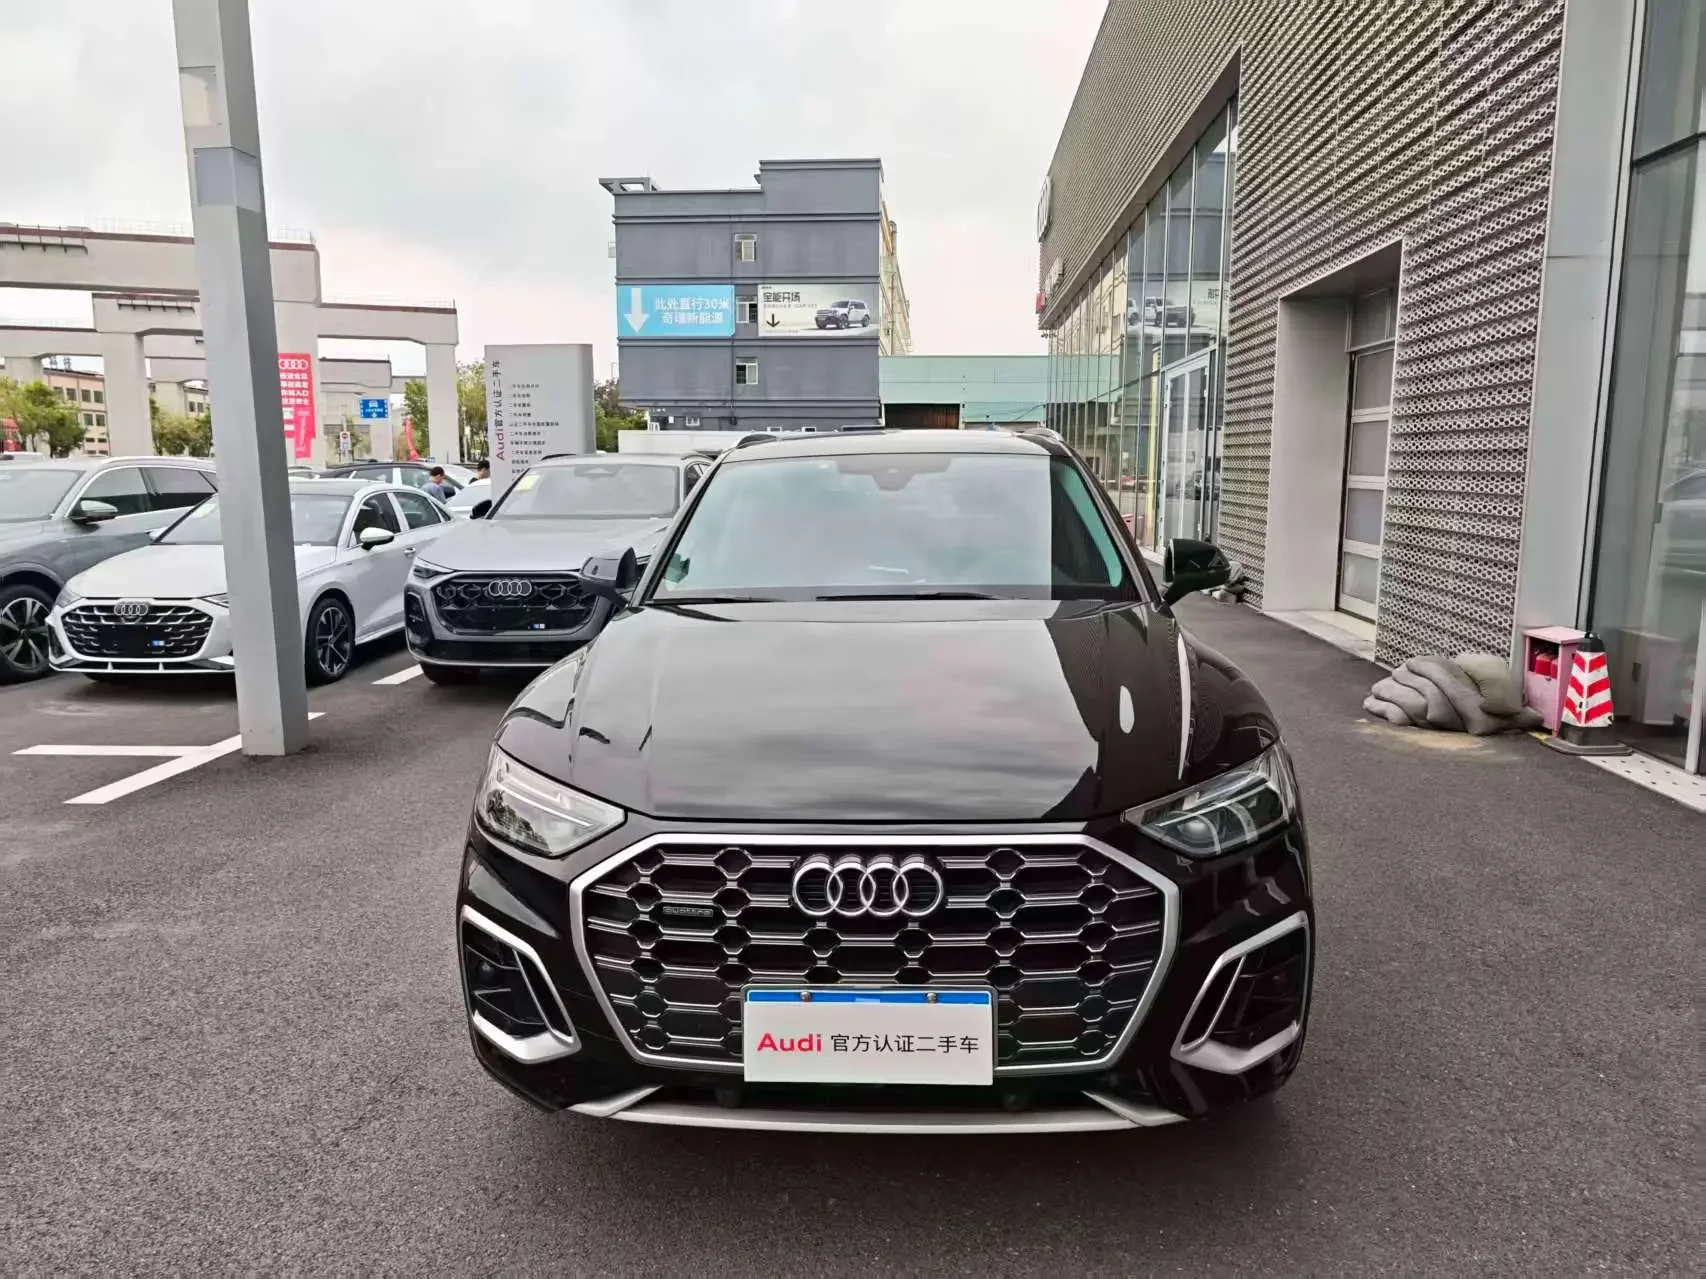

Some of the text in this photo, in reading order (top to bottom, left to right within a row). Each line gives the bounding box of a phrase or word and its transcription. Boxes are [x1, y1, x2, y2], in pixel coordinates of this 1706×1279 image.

[492, 360, 505, 462] Audi 官方认证二手车
[757, 1033, 980, 1054] Audi 官方认证二手车
